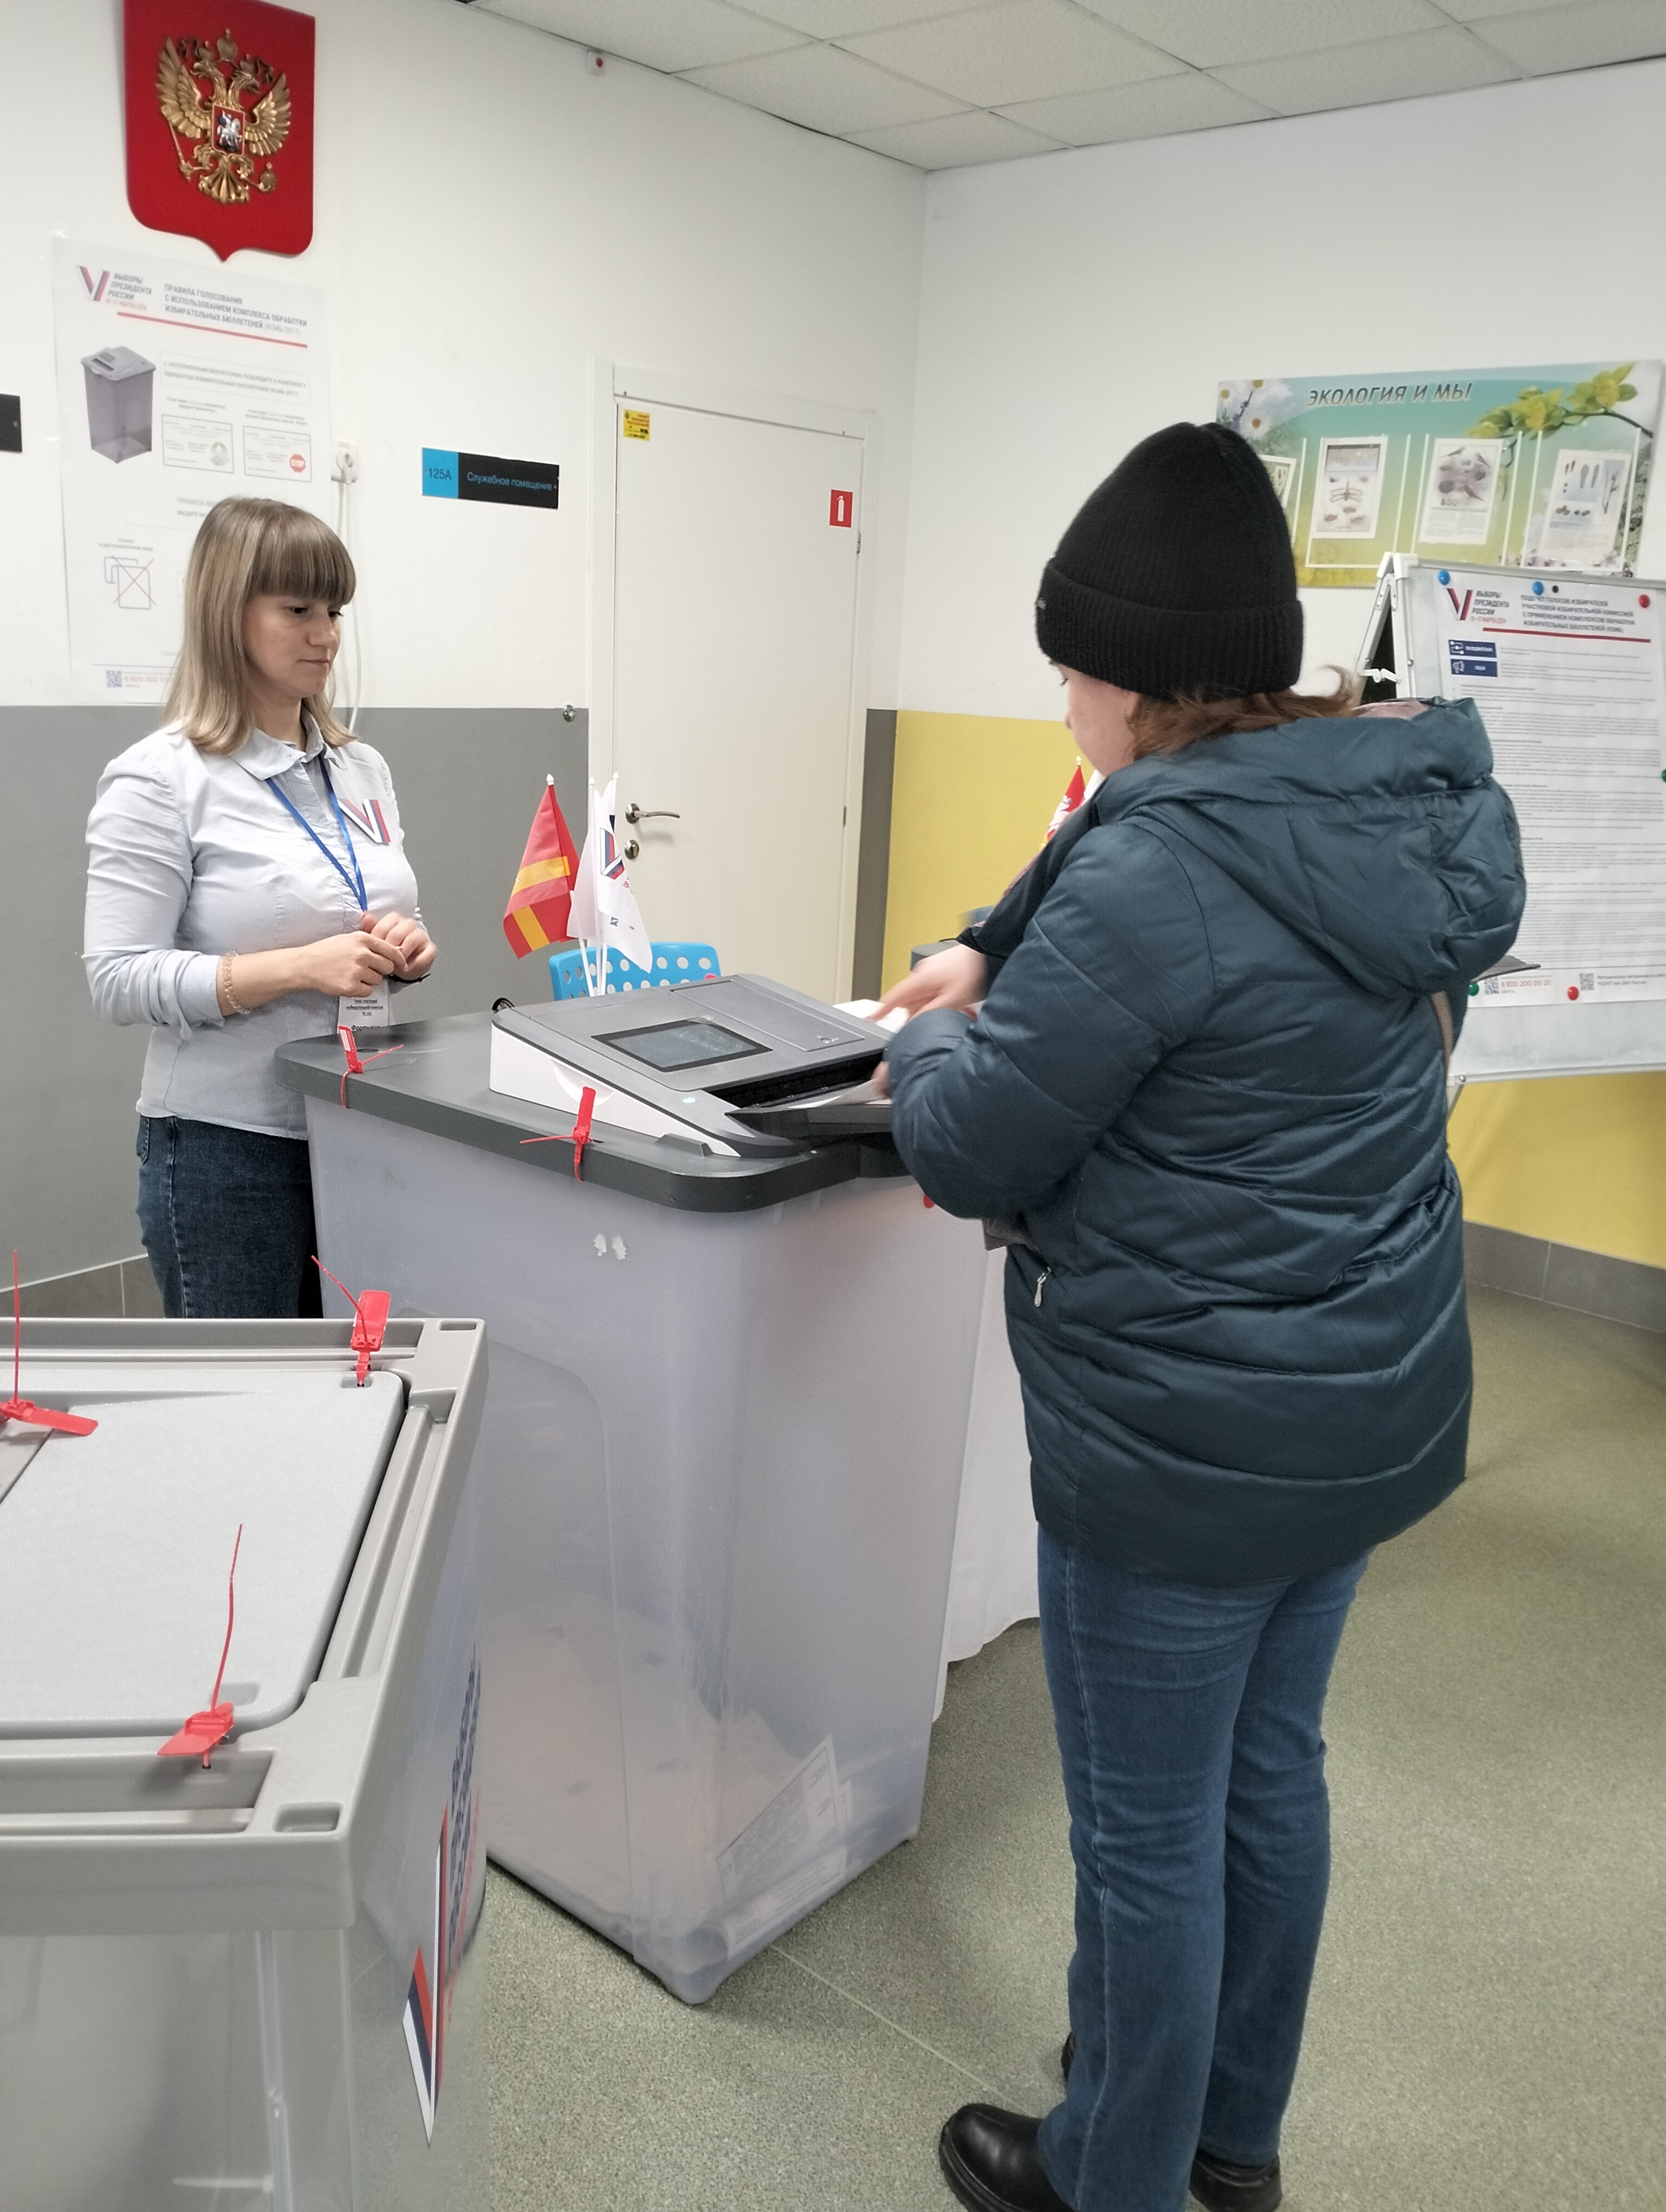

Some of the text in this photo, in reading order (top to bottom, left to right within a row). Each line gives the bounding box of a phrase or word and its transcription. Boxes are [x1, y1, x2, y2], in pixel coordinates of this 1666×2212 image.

[111, 281, 152, 294] ПРЕЗИДЕНТА
[114, 273, 143, 284] ВЫБОРЫ
[107, 290, 134, 300] РОССИИ
[165, 284, 243, 305] ПРАВИЛА ГОЛОСОВАНИЯ
[165, 305, 300, 336] ИЗБИРАТЕЛЬНЫХ БЮЛЛЕТЕНЕЙ (КОИБ-2017)
[171, 295, 232, 313] ИСПОЛЬЗОВАНИЕМ
[233, 307, 271, 320] КОМПЛЕКСА
[272, 314, 307, 327] ОБРАБОТКИ
[1306, 382, 1473, 406] ЭКОЛОГИЯ И МЫ
[467, 471, 552, 491] Служебное помещение
